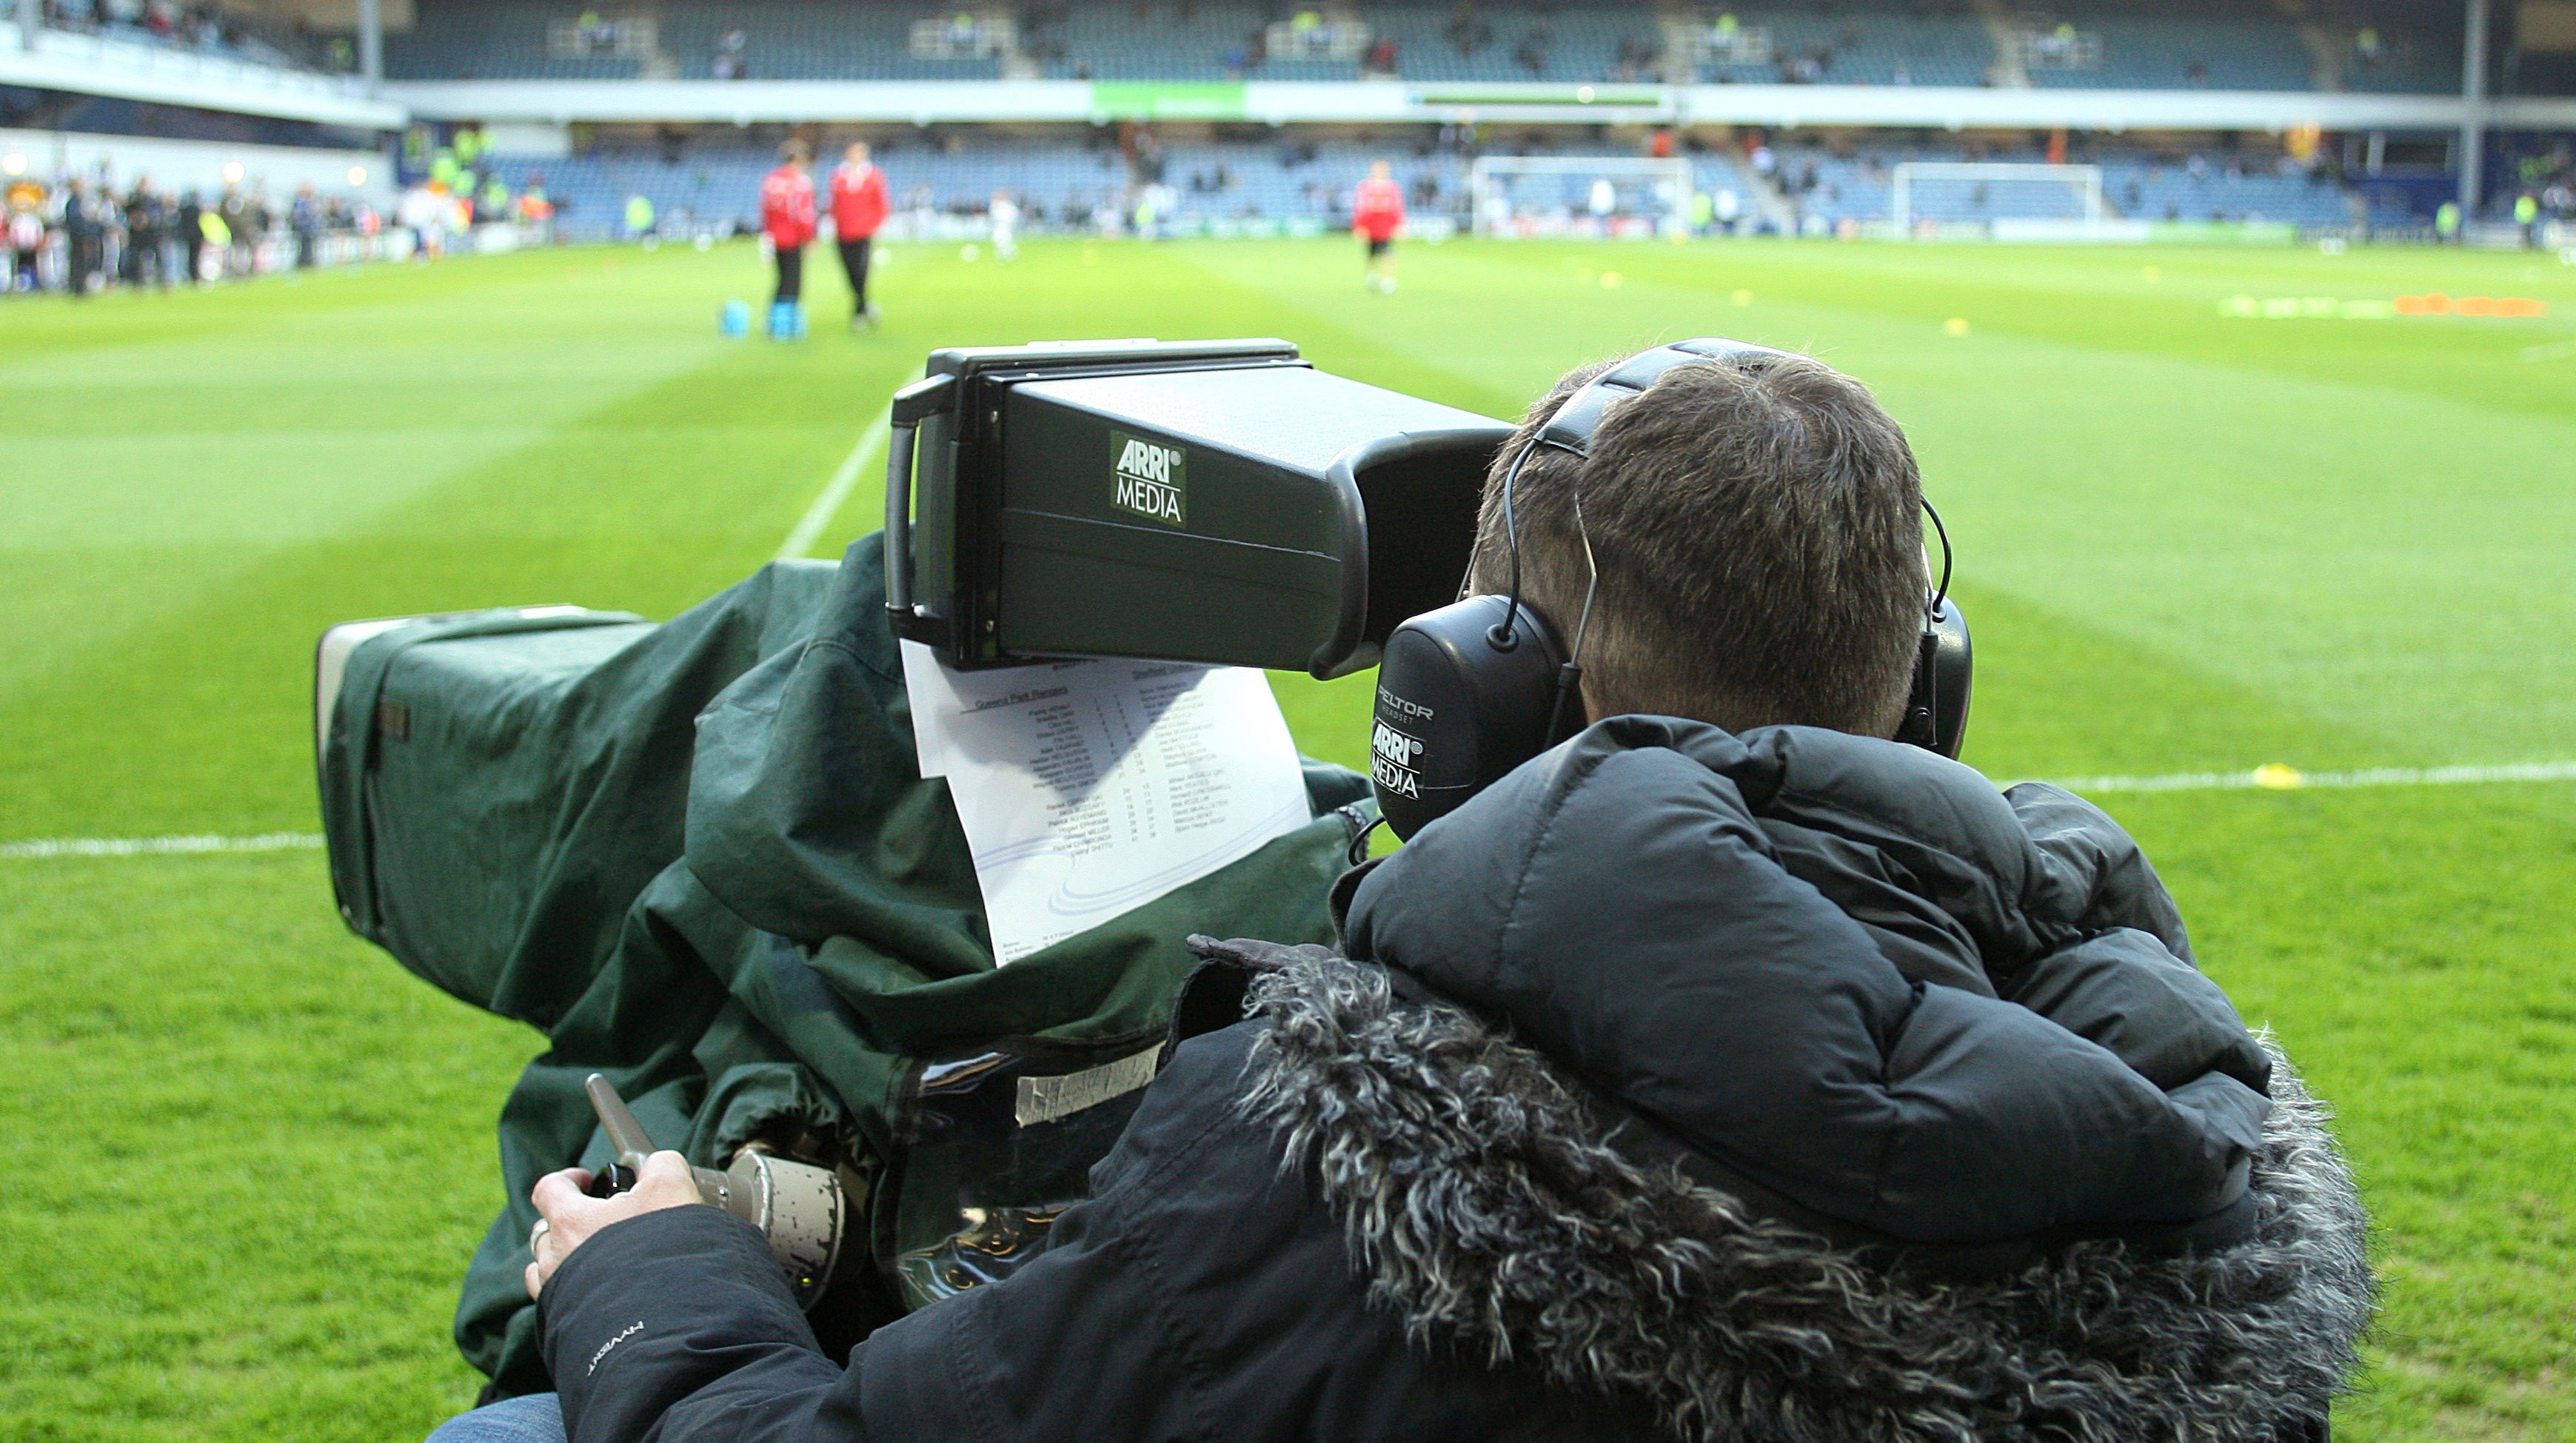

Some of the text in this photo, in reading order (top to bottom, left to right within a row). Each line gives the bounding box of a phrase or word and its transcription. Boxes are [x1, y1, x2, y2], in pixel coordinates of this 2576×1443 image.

[1117, 476, 1182, 523] MEDIA
[1382, 705, 1414, 725] HEADSET
[1371, 751, 1419, 799] MEDIA
